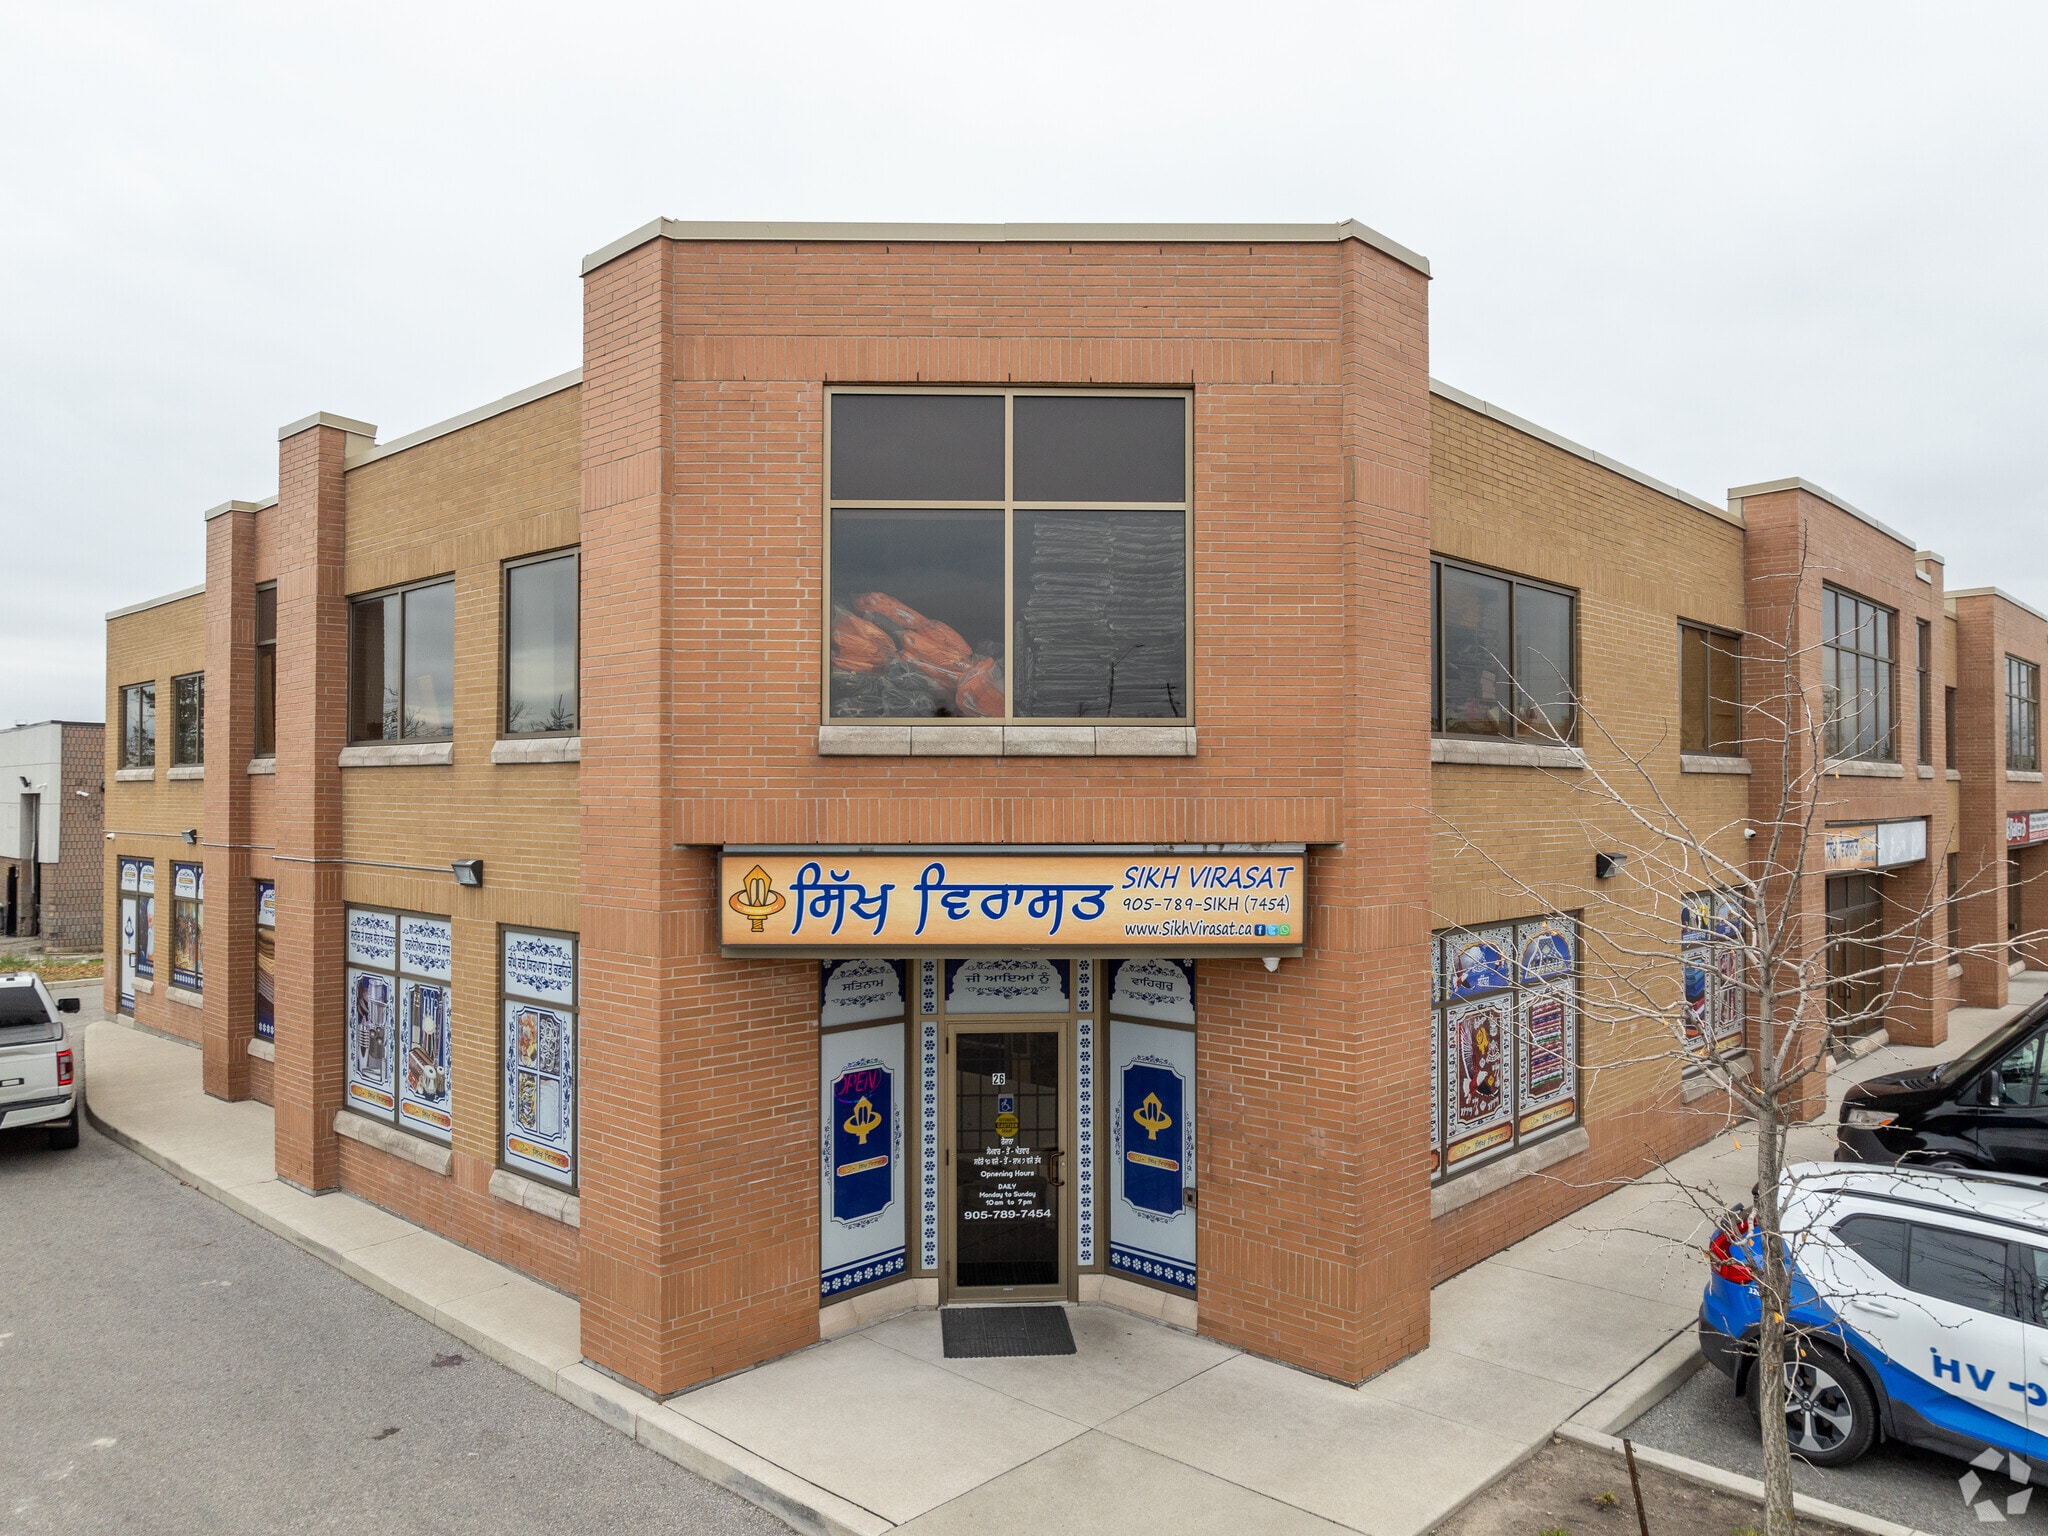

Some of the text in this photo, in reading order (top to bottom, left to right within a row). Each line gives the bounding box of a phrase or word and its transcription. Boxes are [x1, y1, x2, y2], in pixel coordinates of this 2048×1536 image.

[1121, 865, 1295, 889] SIKH VIRASAT
[790, 862, 1114, 935] ਸਿੱਖ ਵਿਰਾਸਤ
[1123, 894, 1291, 915] 905-789-SIKH (7454)
[1125, 919, 1252, 938] www.SikhVirasat.ca
[841, 979, 884, 991] ਸਤਿਨਾਮ
[965, 972, 1050, 984] ਜੀ ਆਇਆਂ ਨੂੰ
[993, 1074, 1004, 1084] 26
[964, 1209, 1051, 1220] 905-789-7454
